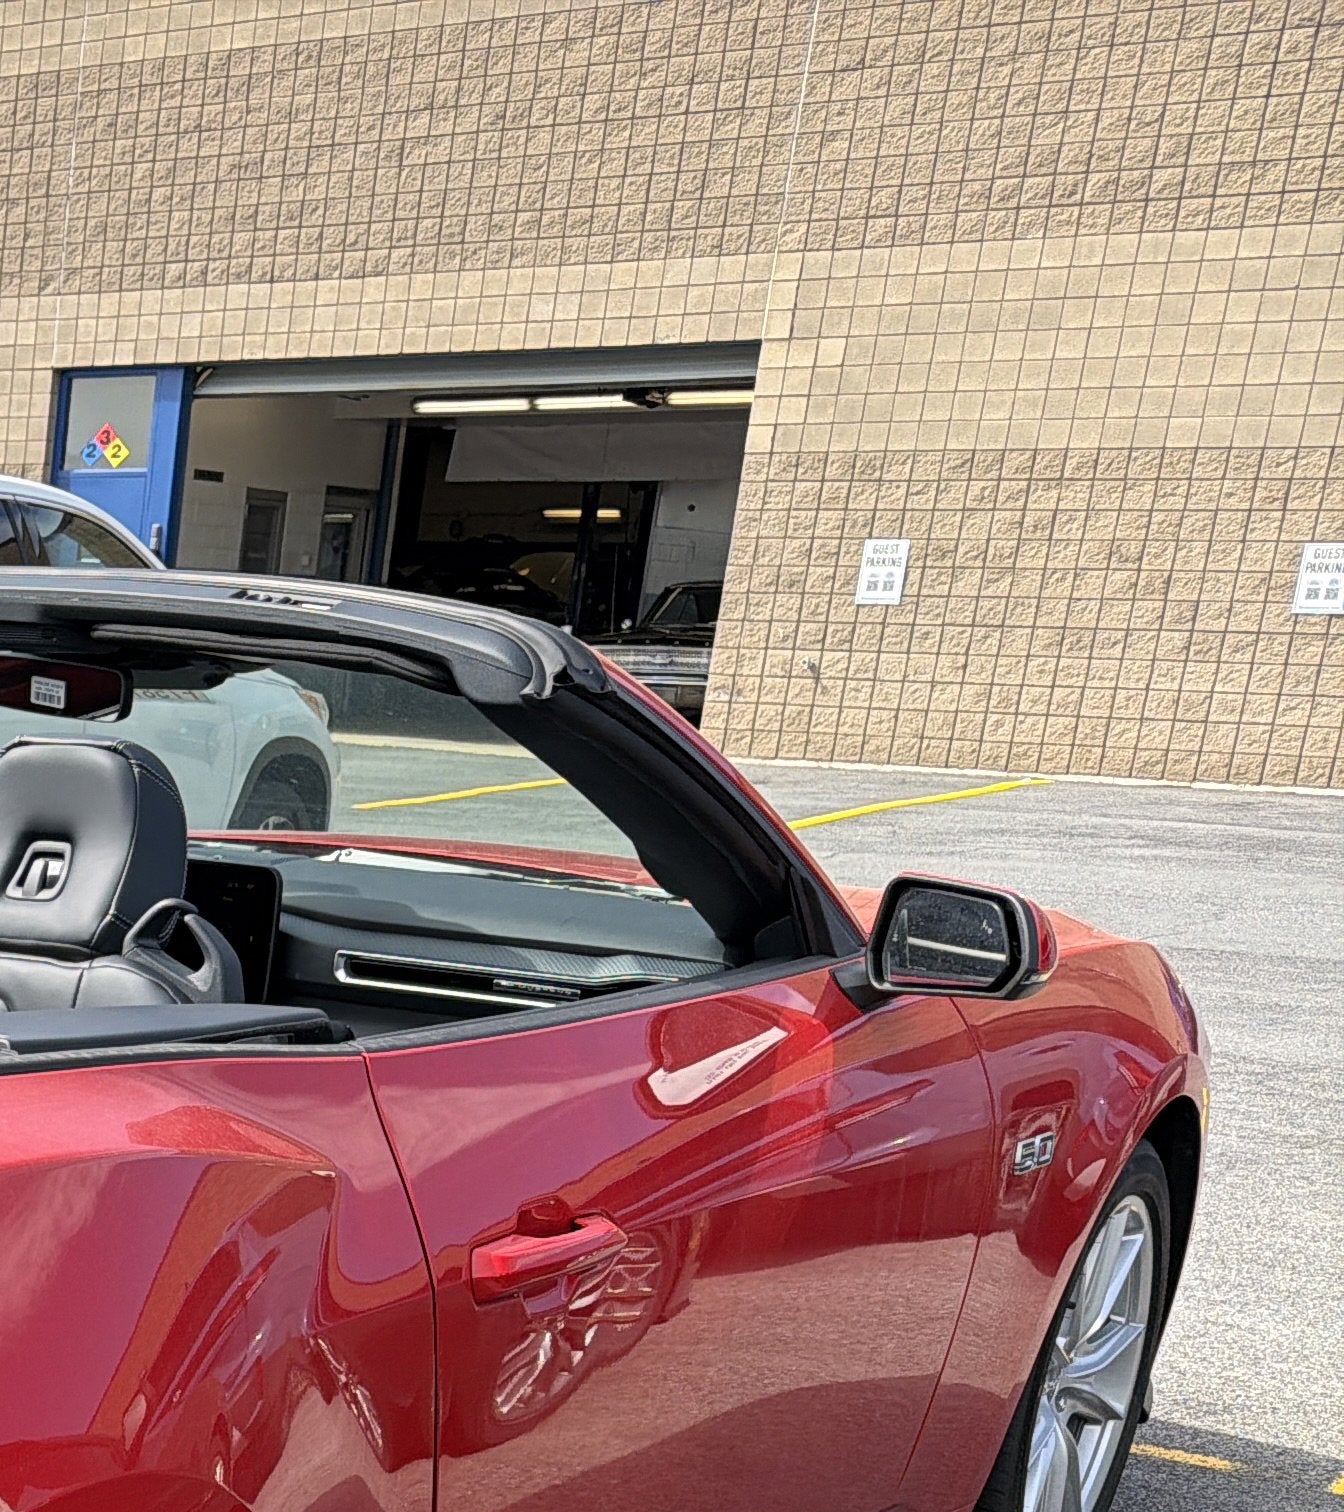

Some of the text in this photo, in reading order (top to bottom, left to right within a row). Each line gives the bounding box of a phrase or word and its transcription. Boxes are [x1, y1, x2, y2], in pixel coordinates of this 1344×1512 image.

[100, 430, 111, 445] 3
[85, 443, 122, 458] 2 2
[872, 543, 900, 554] GUEST
[865, 556, 902, 567] PARKING
